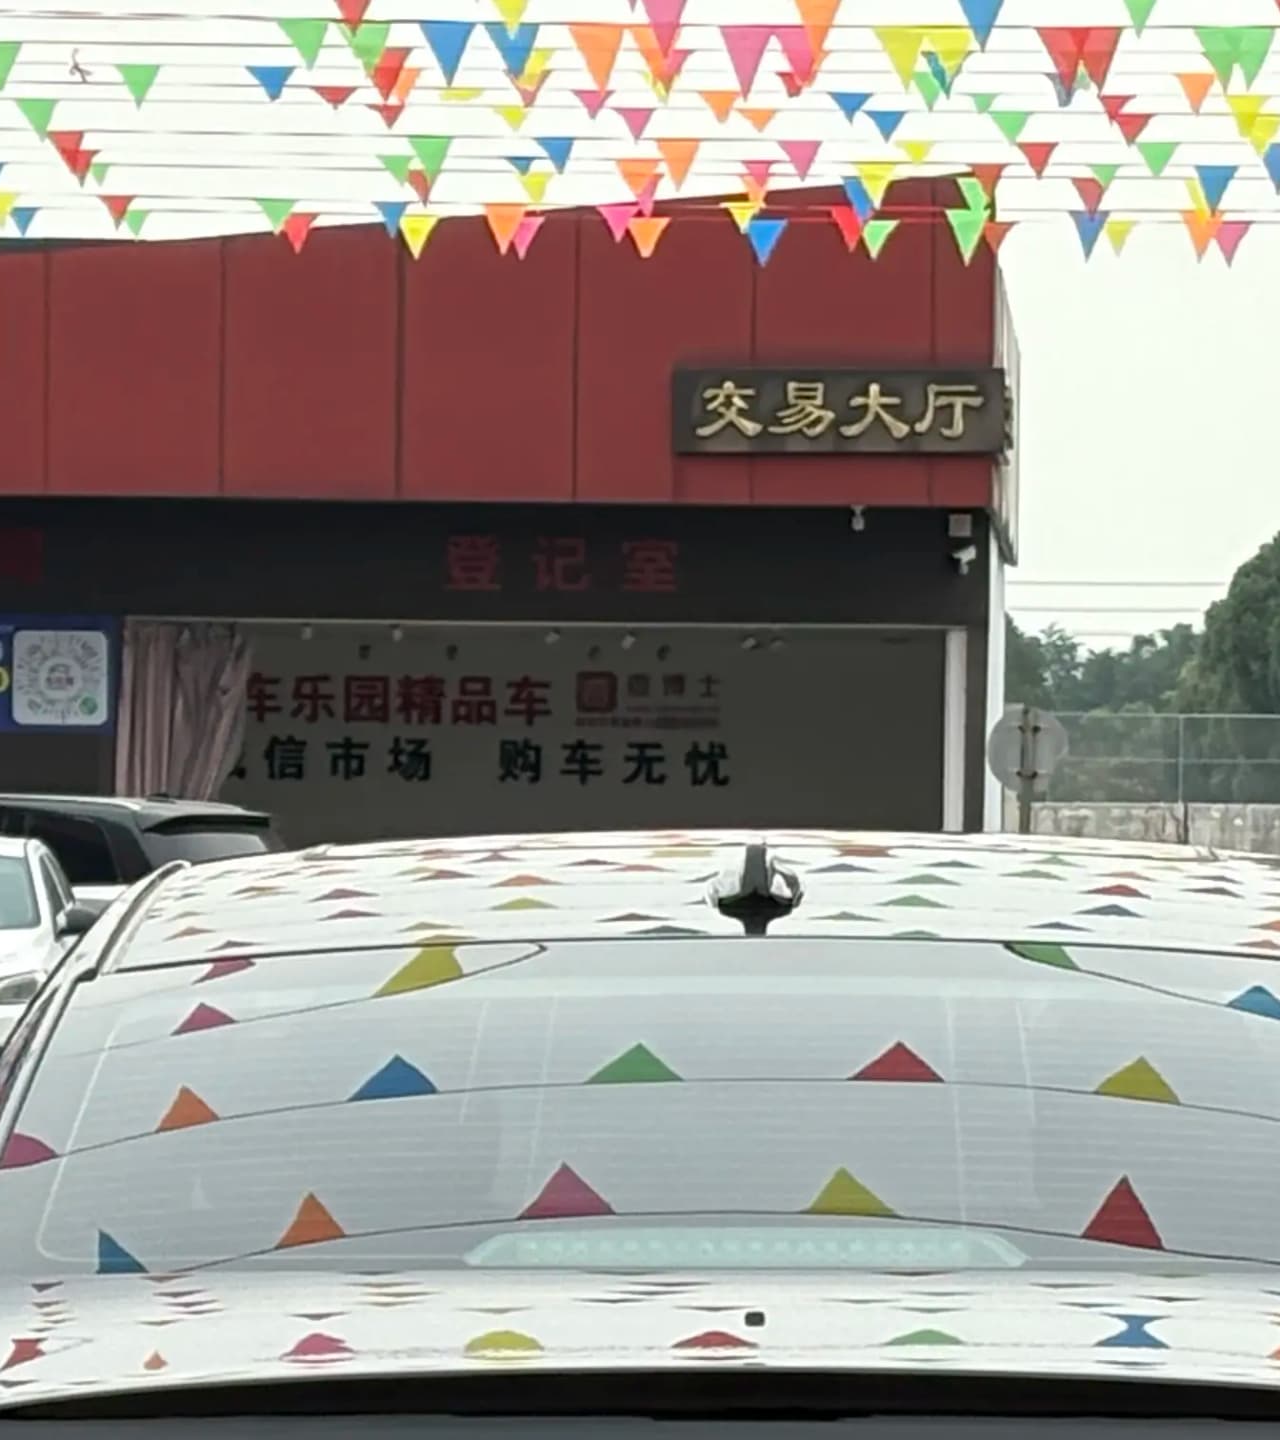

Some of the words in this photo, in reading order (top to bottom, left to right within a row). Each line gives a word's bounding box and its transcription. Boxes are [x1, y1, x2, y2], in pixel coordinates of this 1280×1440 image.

[695, 380, 984, 440] 交易大厅
[444, 535, 678, 592] 登记室
[247, 672, 553, 726] 车乐园精品车
[228, 735, 432, 782] 信市场
[498, 737, 731, 787] 购车无忧
